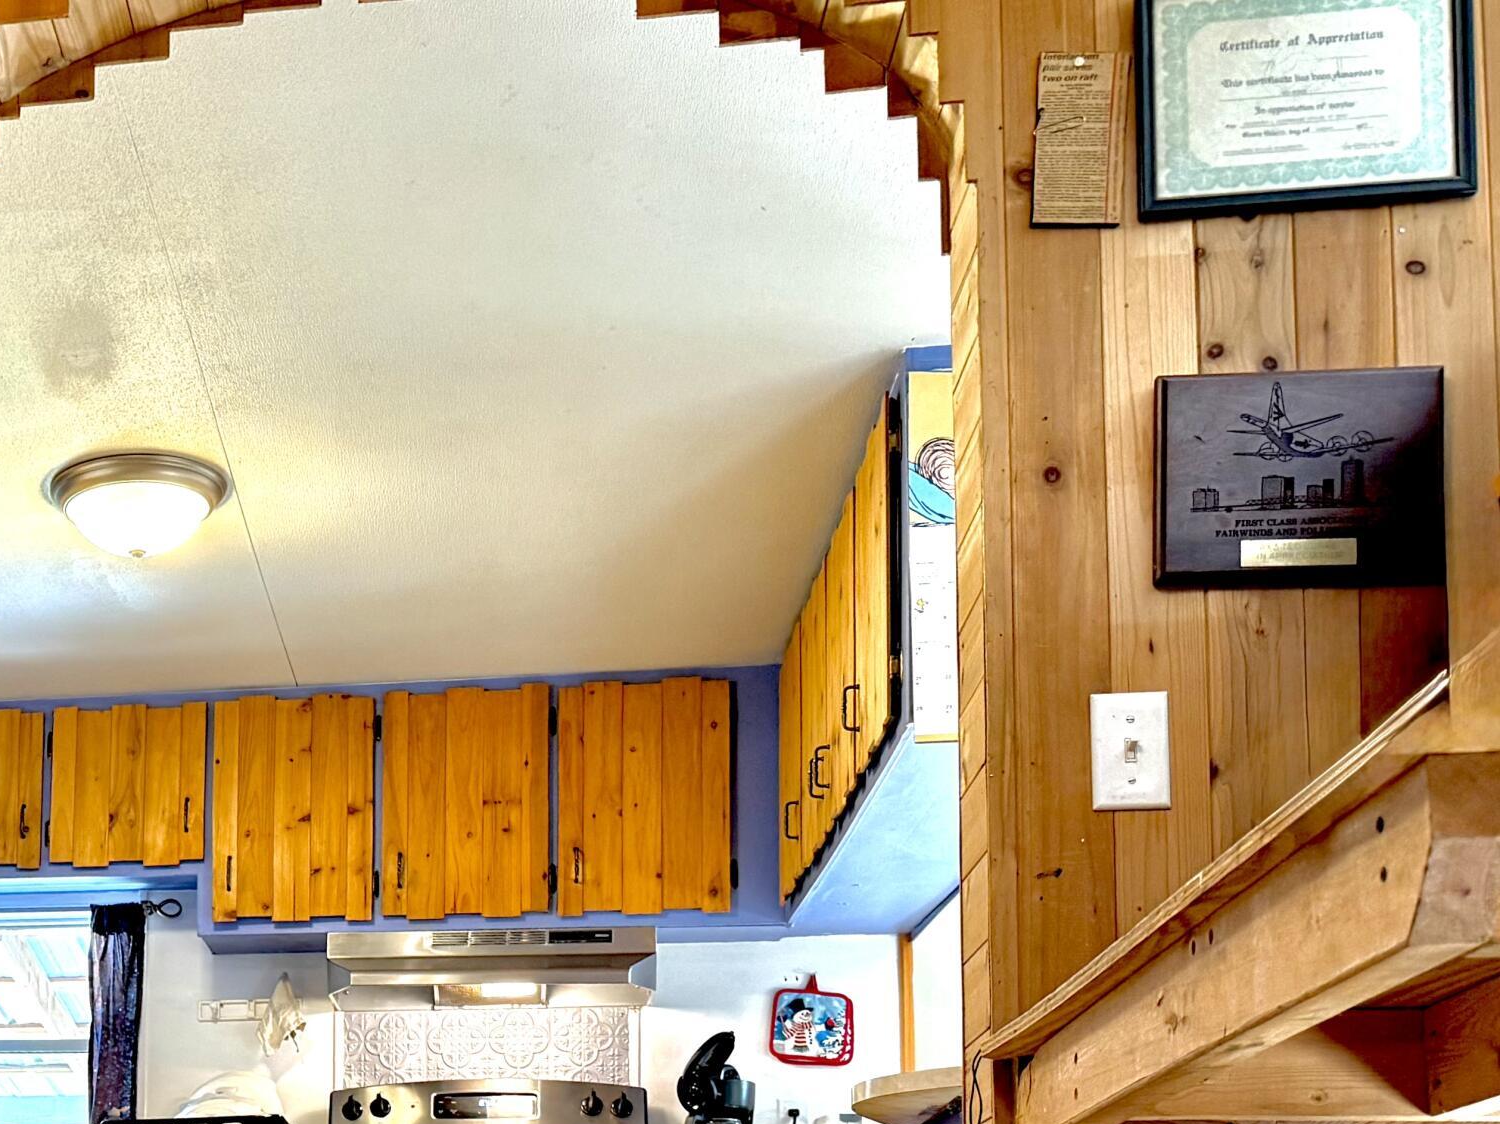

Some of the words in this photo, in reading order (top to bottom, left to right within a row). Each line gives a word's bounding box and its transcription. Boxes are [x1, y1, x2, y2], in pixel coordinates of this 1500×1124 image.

[1219, 38, 1281, 53] Certificate
[1307, 30, 1384, 46] Appreciation
[1042, 74, 1062, 82] two
[1079, 73, 1099, 81] raft
[1235, 519, 1264, 528] FIRST
[1215, 528, 1274, 538] FAIRWINDS
